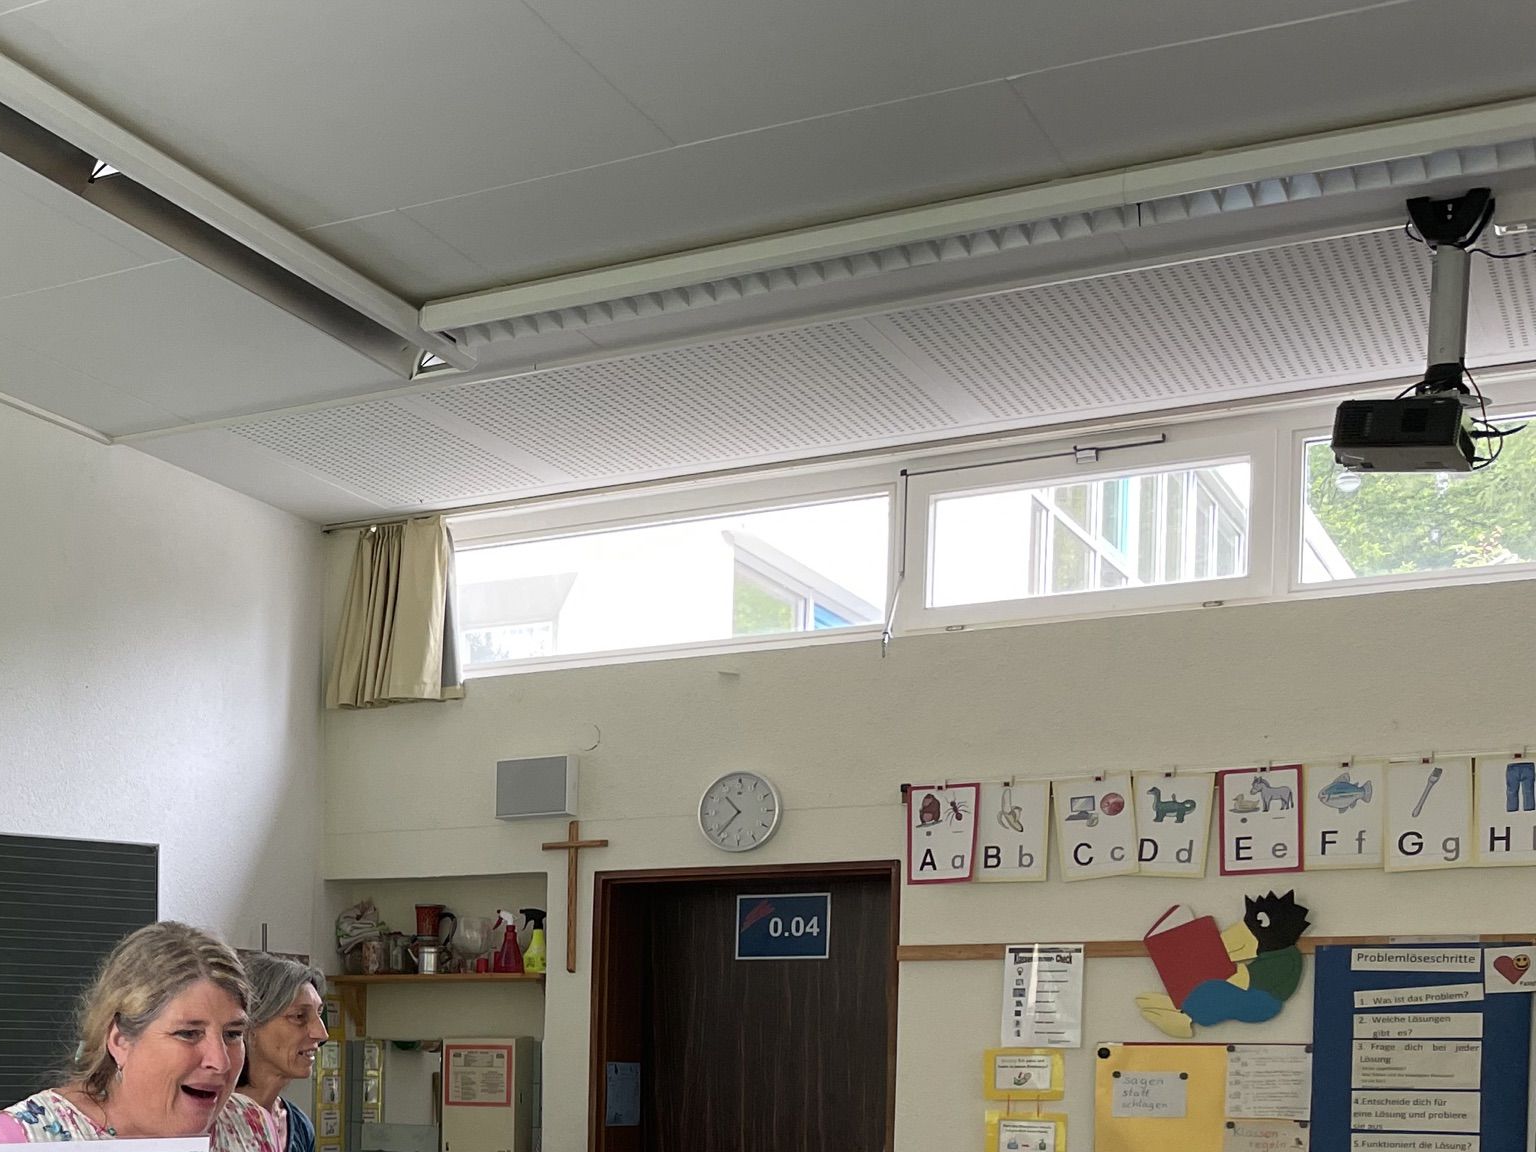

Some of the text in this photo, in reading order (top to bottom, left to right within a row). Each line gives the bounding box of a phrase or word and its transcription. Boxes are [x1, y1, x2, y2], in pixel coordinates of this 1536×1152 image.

[1320, 830, 1367, 855] F f
[1489, 826, 1511, 851] H
[1138, 839, 1193, 864] D d
[1235, 836, 1288, 860] E e
[1397, 831, 1460, 861] G g
[919, 848, 965, 871] A a
[983, 845, 1034, 868] B b
[1073, 842, 1125, 866] C c
[769, 916, 820, 937] 0.04
[1357, 953, 1476, 964] Problemlöseschritte
[1372, 996, 1394, 1005] Was
[1394, 996, 1406, 1004] ist
[1407, 994, 1423, 1003] das
[1425, 991, 1469, 1002] Problem?
[1372, 1015, 1406, 1024] Welche
[1408, 1015, 1451, 1025] Lösungen
[1372, 1029, 1413, 1038] gibt es?
[1370, 1043, 1395, 1052] Frage
[1404, 1043, 1423, 1051] dich
[1432, 1043, 1446, 1051] bei
[1455, 1044, 1480, 1053] jeder
[1360, 1055, 1391, 1065] Lösung
[1121, 1089, 1151, 1099] statt
[1413, 1098, 1431, 1107] dich
[1434, 1098, 1448, 1107] für
[1375, 1110, 1406, 1120] Lösung
[1408, 1111, 1425, 1119] und
[1428, 1111, 1467, 1121] probiere
[1419, 1141, 1433, 1149] die
[1435, 1142, 1472, 1151] Lösung?
